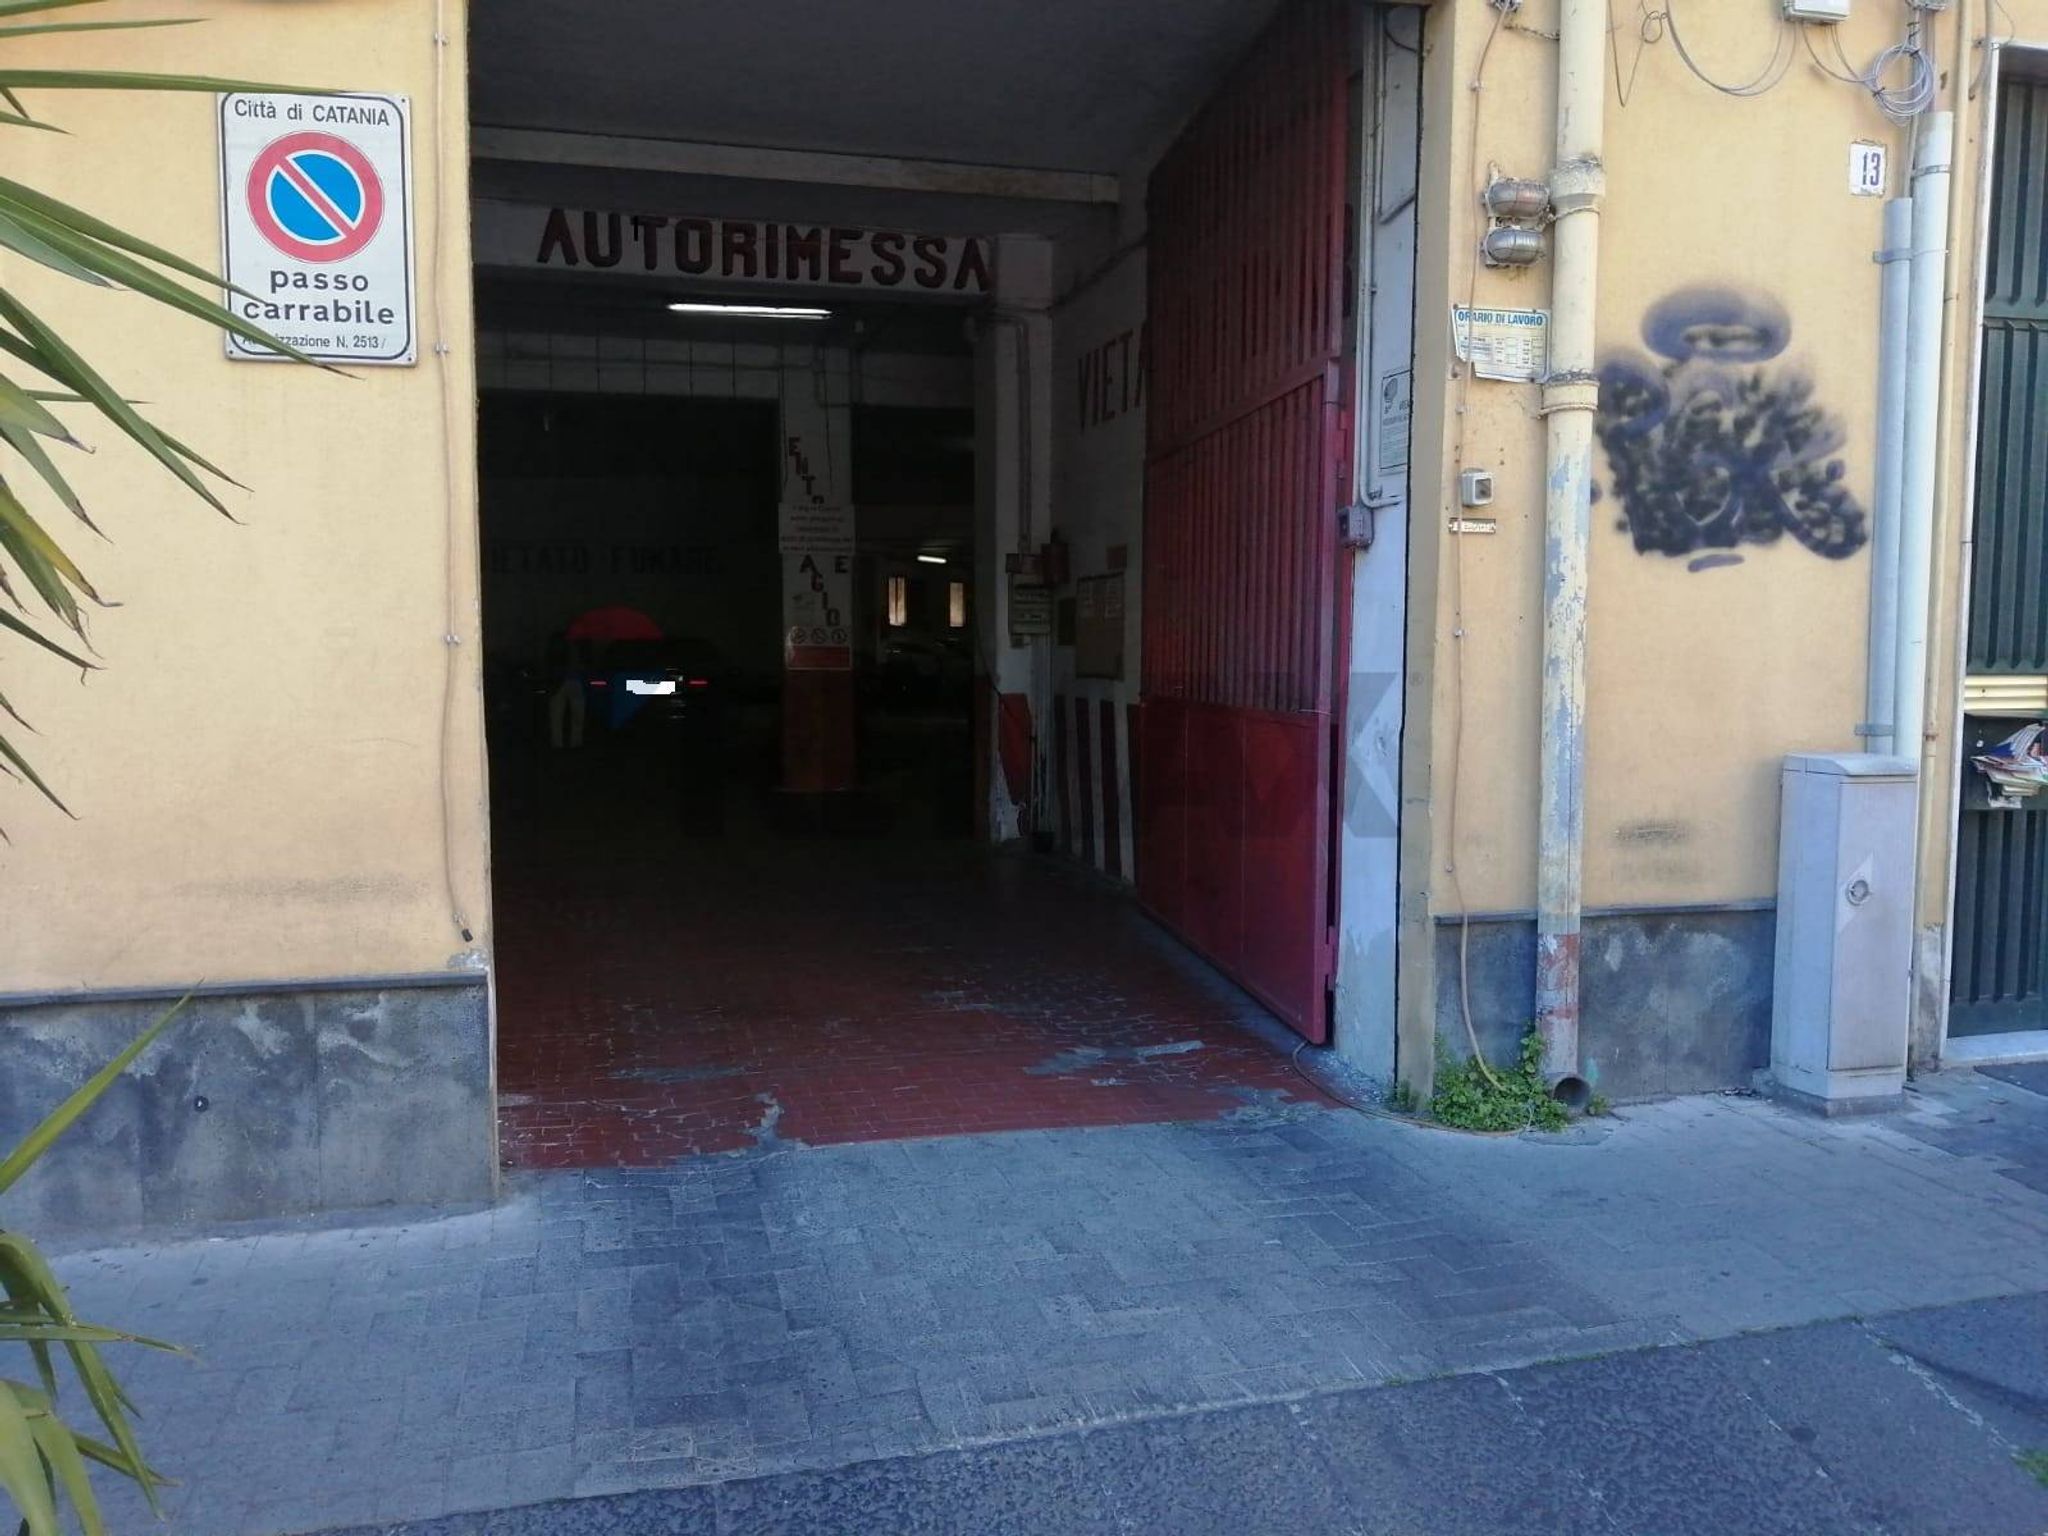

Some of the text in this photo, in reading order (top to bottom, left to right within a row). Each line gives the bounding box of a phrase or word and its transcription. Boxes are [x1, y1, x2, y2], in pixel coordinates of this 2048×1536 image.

[234, 99, 389, 126] Città di CATANIA
[1862, 152, 1881, 186] 13
[537, 206, 992, 292] AUTORIMESSA
[270, 269, 370, 293] passo
[243, 299, 396, 325] carrabile
[1457, 311, 1543, 326] ORARIO DI LAVORO
[336, 335, 348, 348] N.
